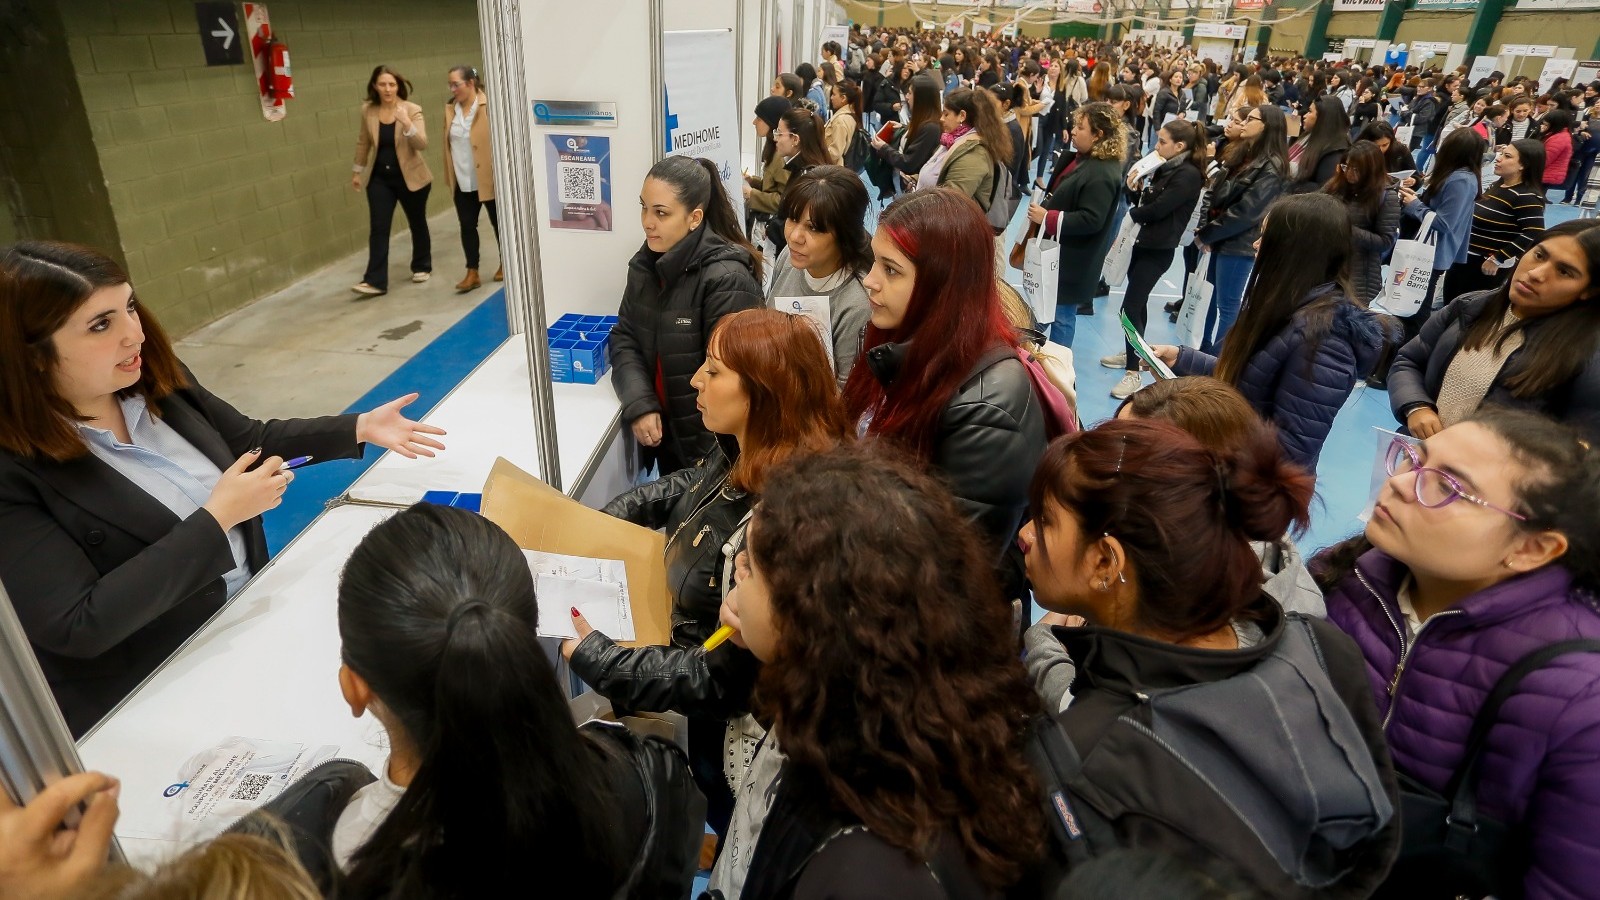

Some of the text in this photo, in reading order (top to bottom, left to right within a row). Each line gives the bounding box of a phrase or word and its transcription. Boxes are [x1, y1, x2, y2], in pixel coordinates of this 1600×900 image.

[674, 126, 720, 150] MEDIHOME
[1413, 267, 1430, 276] Expo
[1410, 274, 1429, 283] Empl
[1407, 280, 1428, 290] Barria
